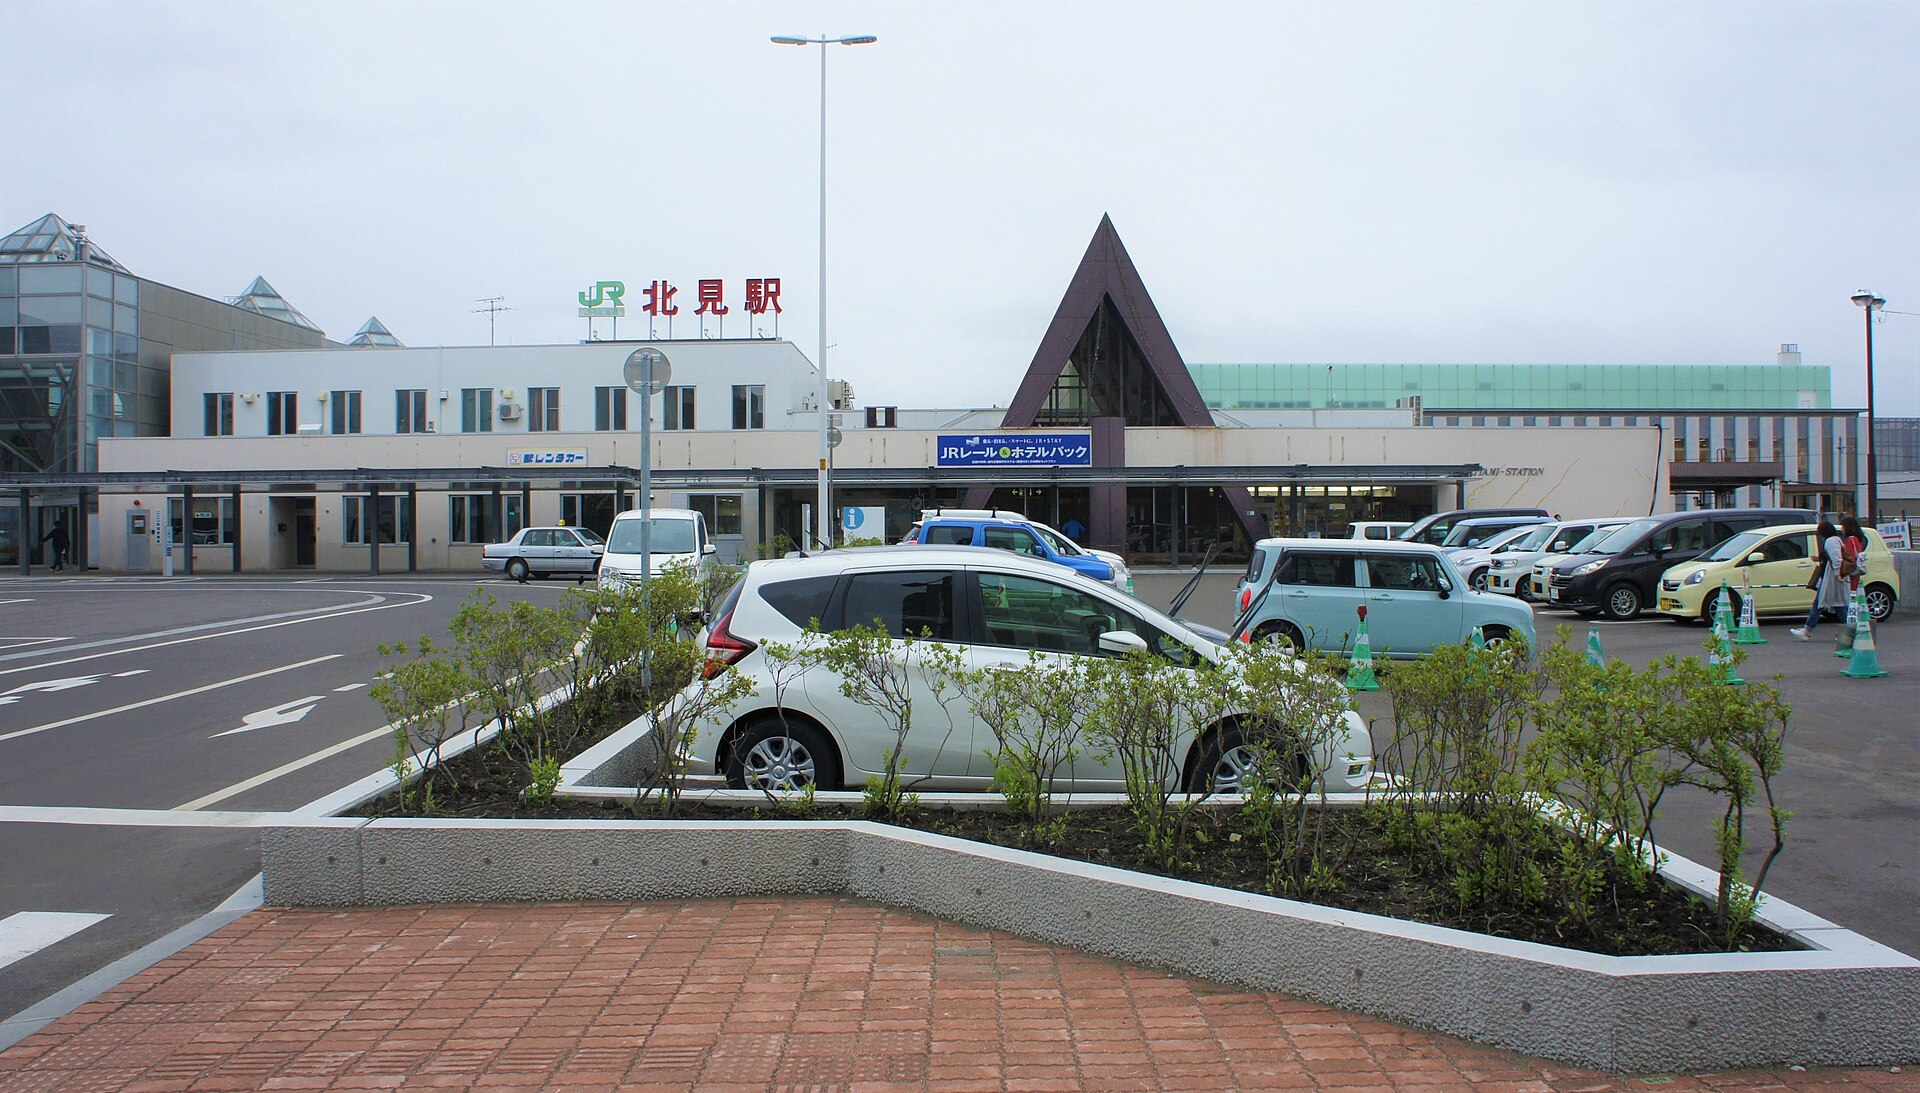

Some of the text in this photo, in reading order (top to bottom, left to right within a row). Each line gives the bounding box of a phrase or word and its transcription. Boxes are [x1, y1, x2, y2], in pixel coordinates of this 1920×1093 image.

[578, 277, 783, 317] JR 北見駅
[523, 453, 584, 464] 駅レンタカー
